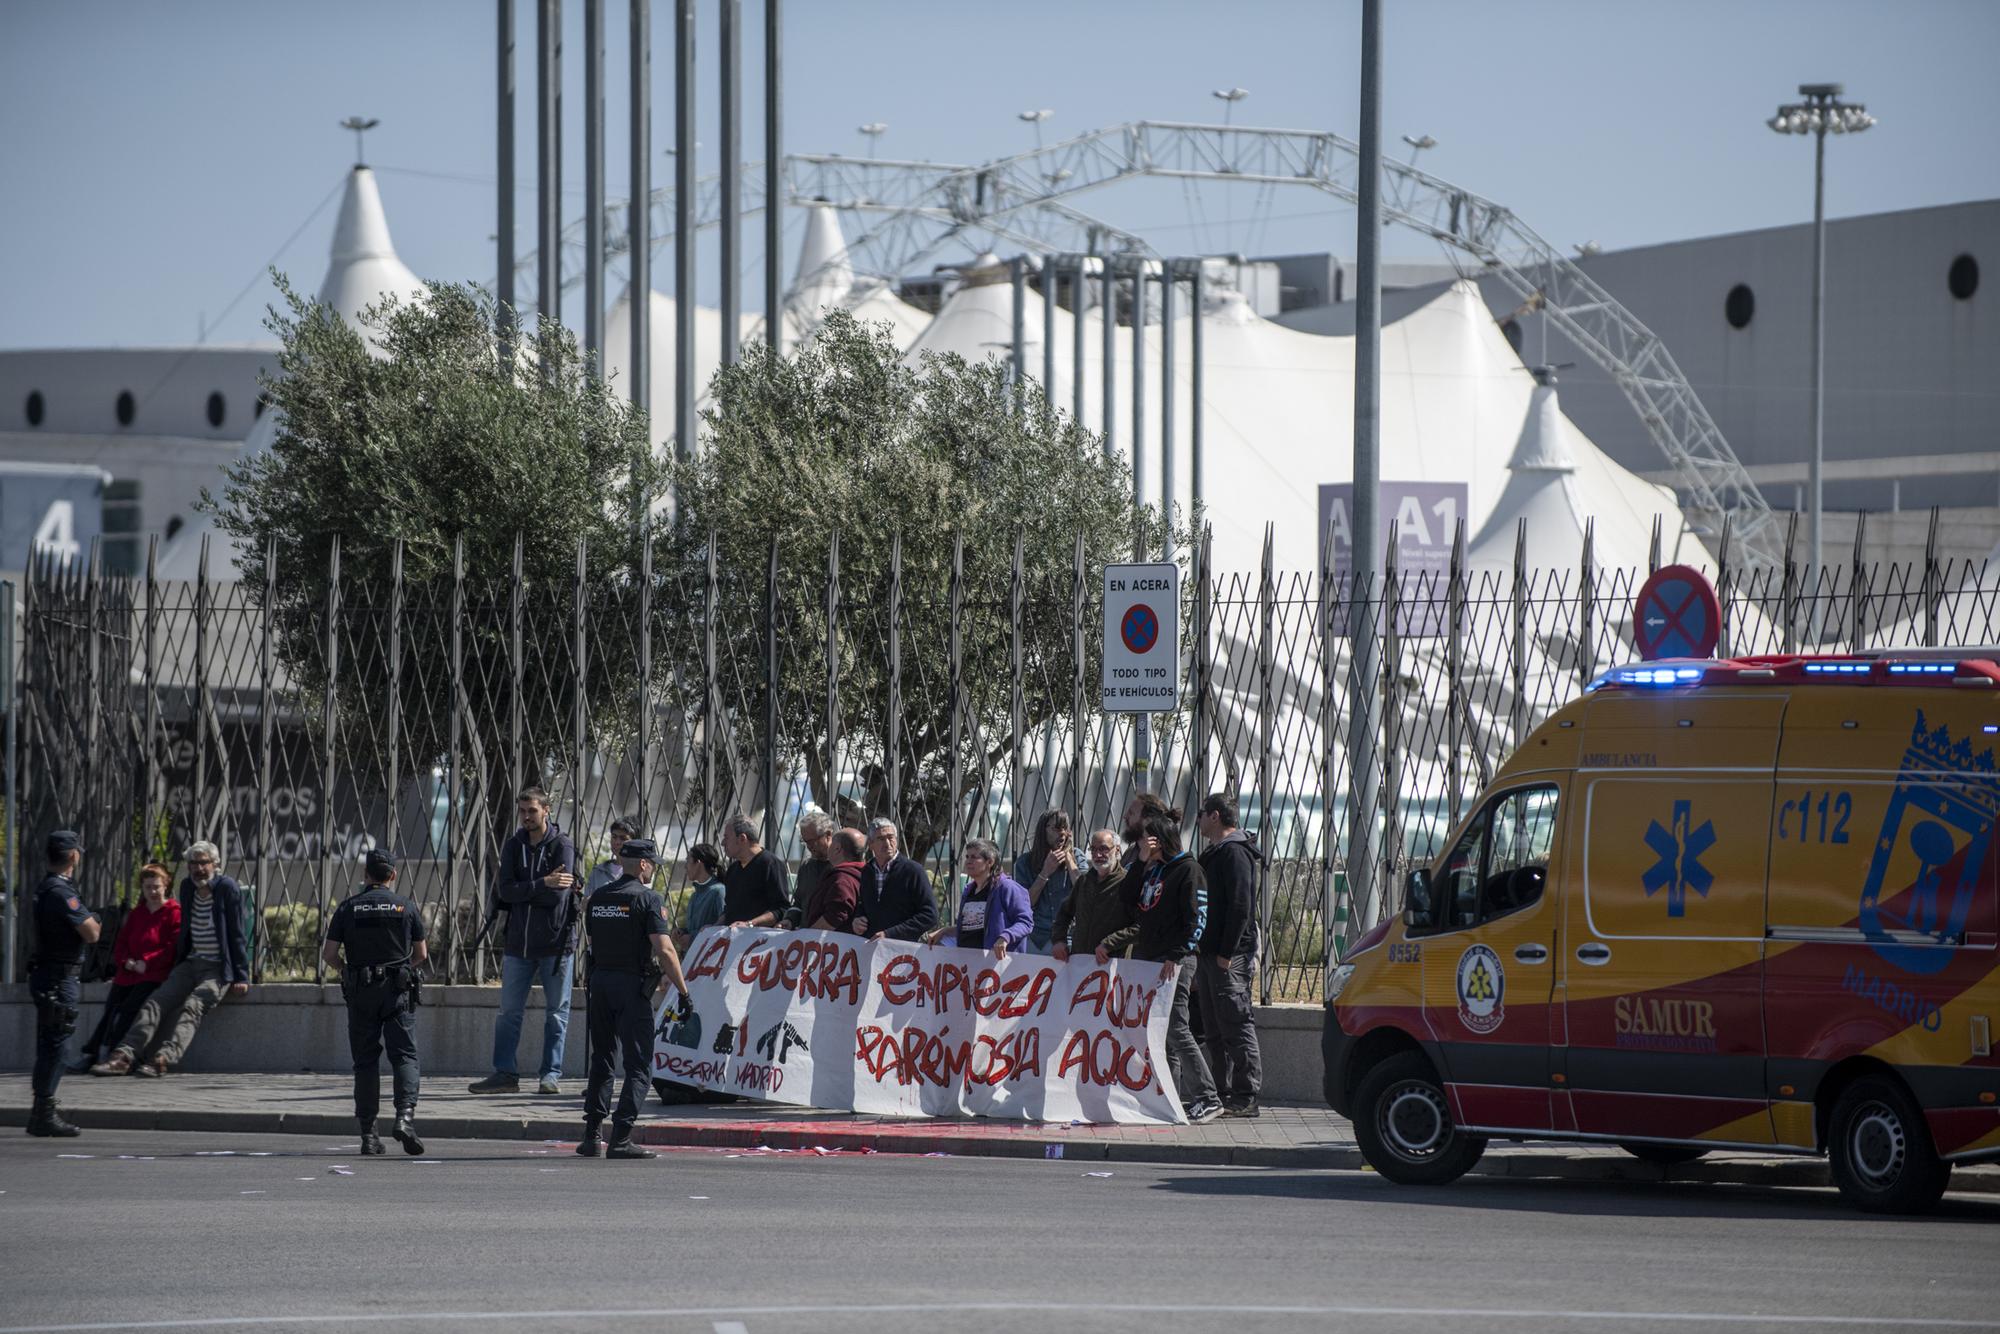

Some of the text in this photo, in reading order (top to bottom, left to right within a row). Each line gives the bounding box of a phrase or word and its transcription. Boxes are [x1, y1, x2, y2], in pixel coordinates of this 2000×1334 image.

[35, 500, 80, 568] 4
[1396, 495, 1458, 546] A1
[1110, 579, 1170, 591] EN ACERA
[1104, 685, 1174, 697] DE VEHÍCULOS
[1112, 668, 1167, 679] TODO TIPO
[1798, 790, 1853, 844] 112
[685, 936, 731, 982] LA
[738, 937, 862, 1005] GUERRA
[1841, 959, 1942, 1033] MADRID
[1615, 996, 1717, 1038] SAMUR
